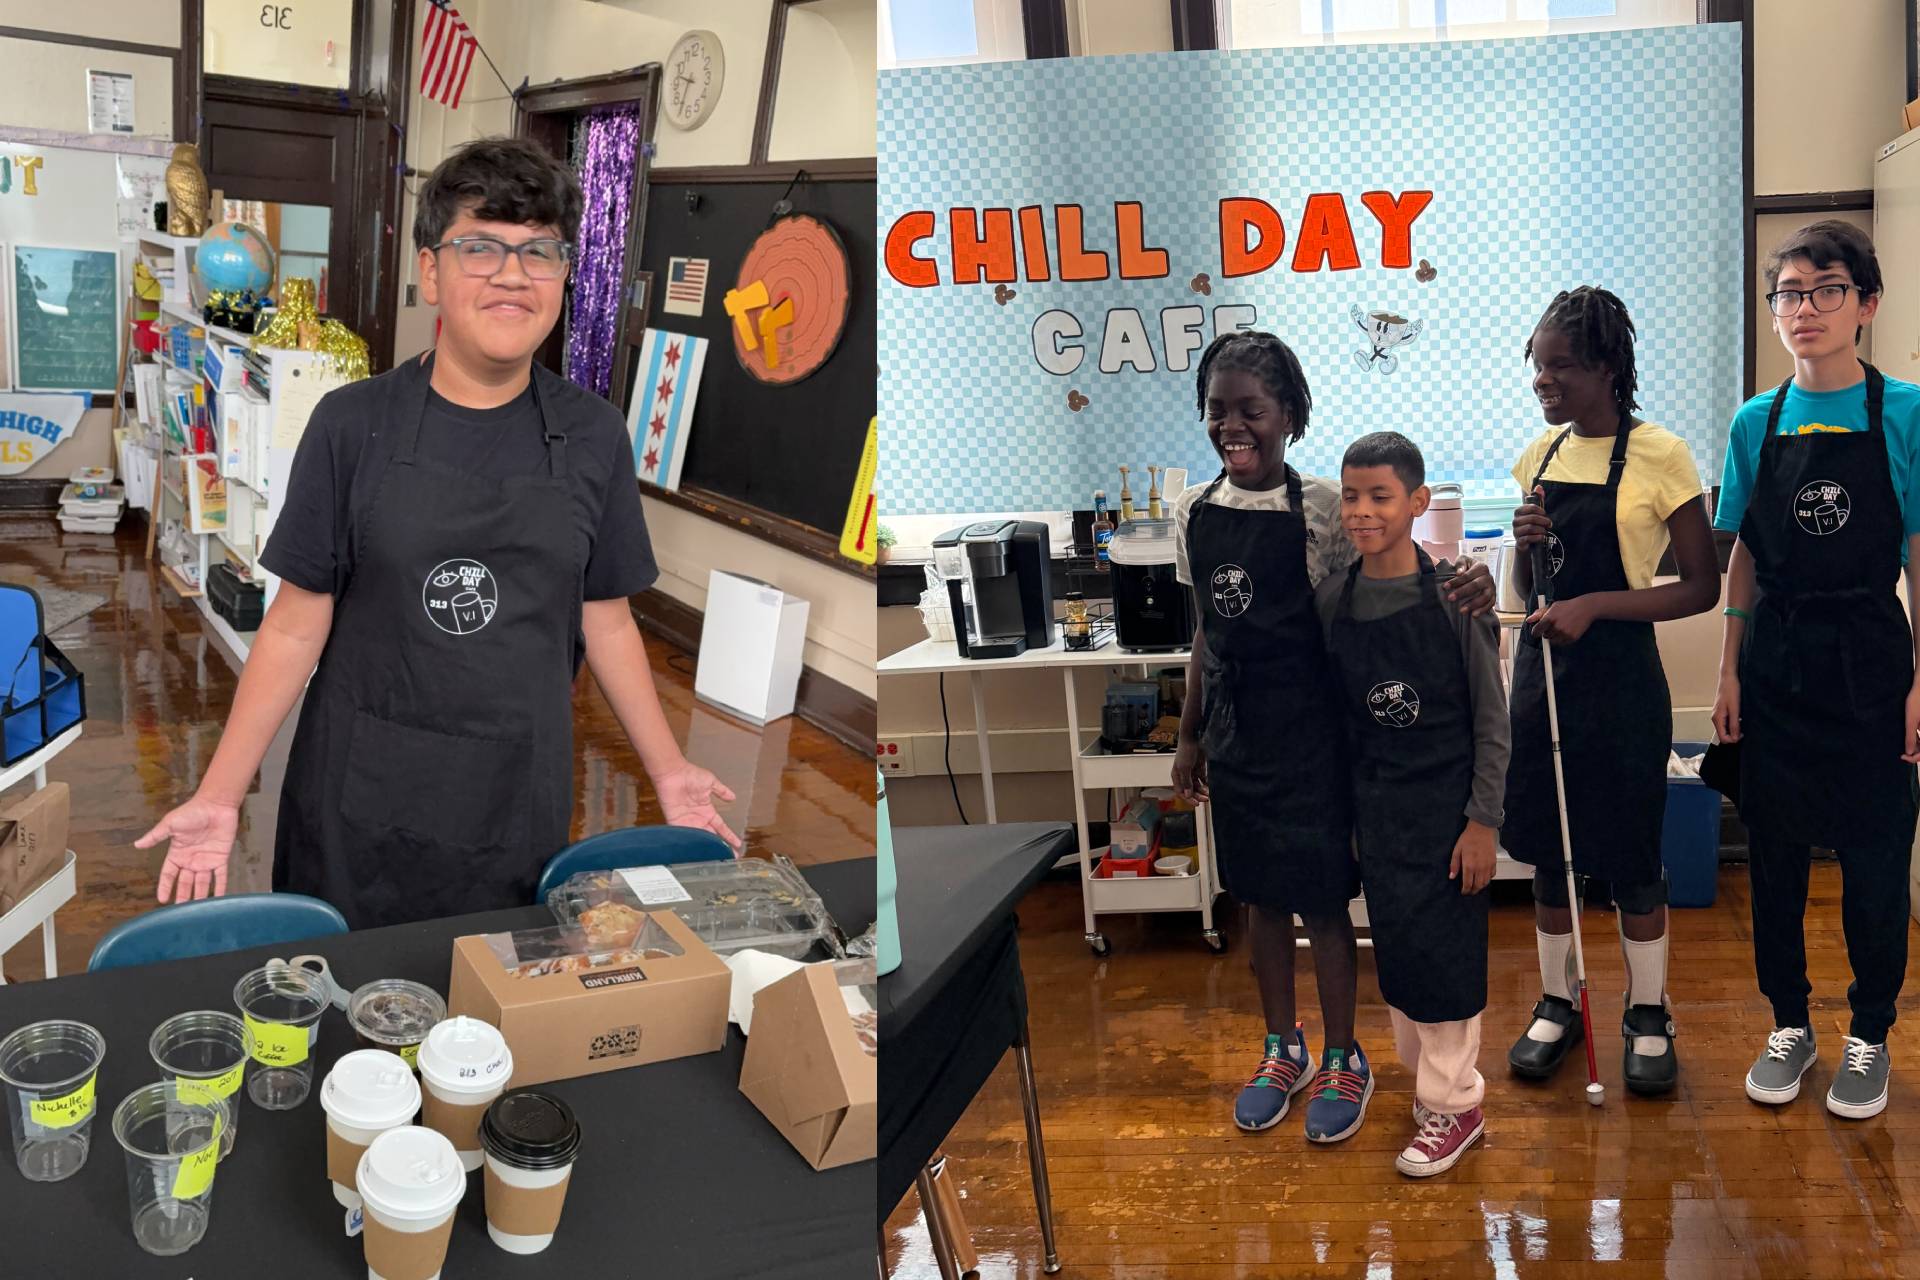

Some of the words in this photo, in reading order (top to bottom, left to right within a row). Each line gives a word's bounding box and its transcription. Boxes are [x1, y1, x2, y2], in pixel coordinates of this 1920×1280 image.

[884, 200, 1170, 289] CHILL
[1218, 190, 1434, 279] DAY
[0, 410, 63, 445] HIGH
[1820, 486, 1841, 495] CHILL
[1823, 493, 1838, 501] DAY
[459, 566, 486, 578] CHILL
[462, 576, 482, 587] DAY
[429, 599, 448, 609] 313
[584, 971, 643, 988] KIRKLAND
